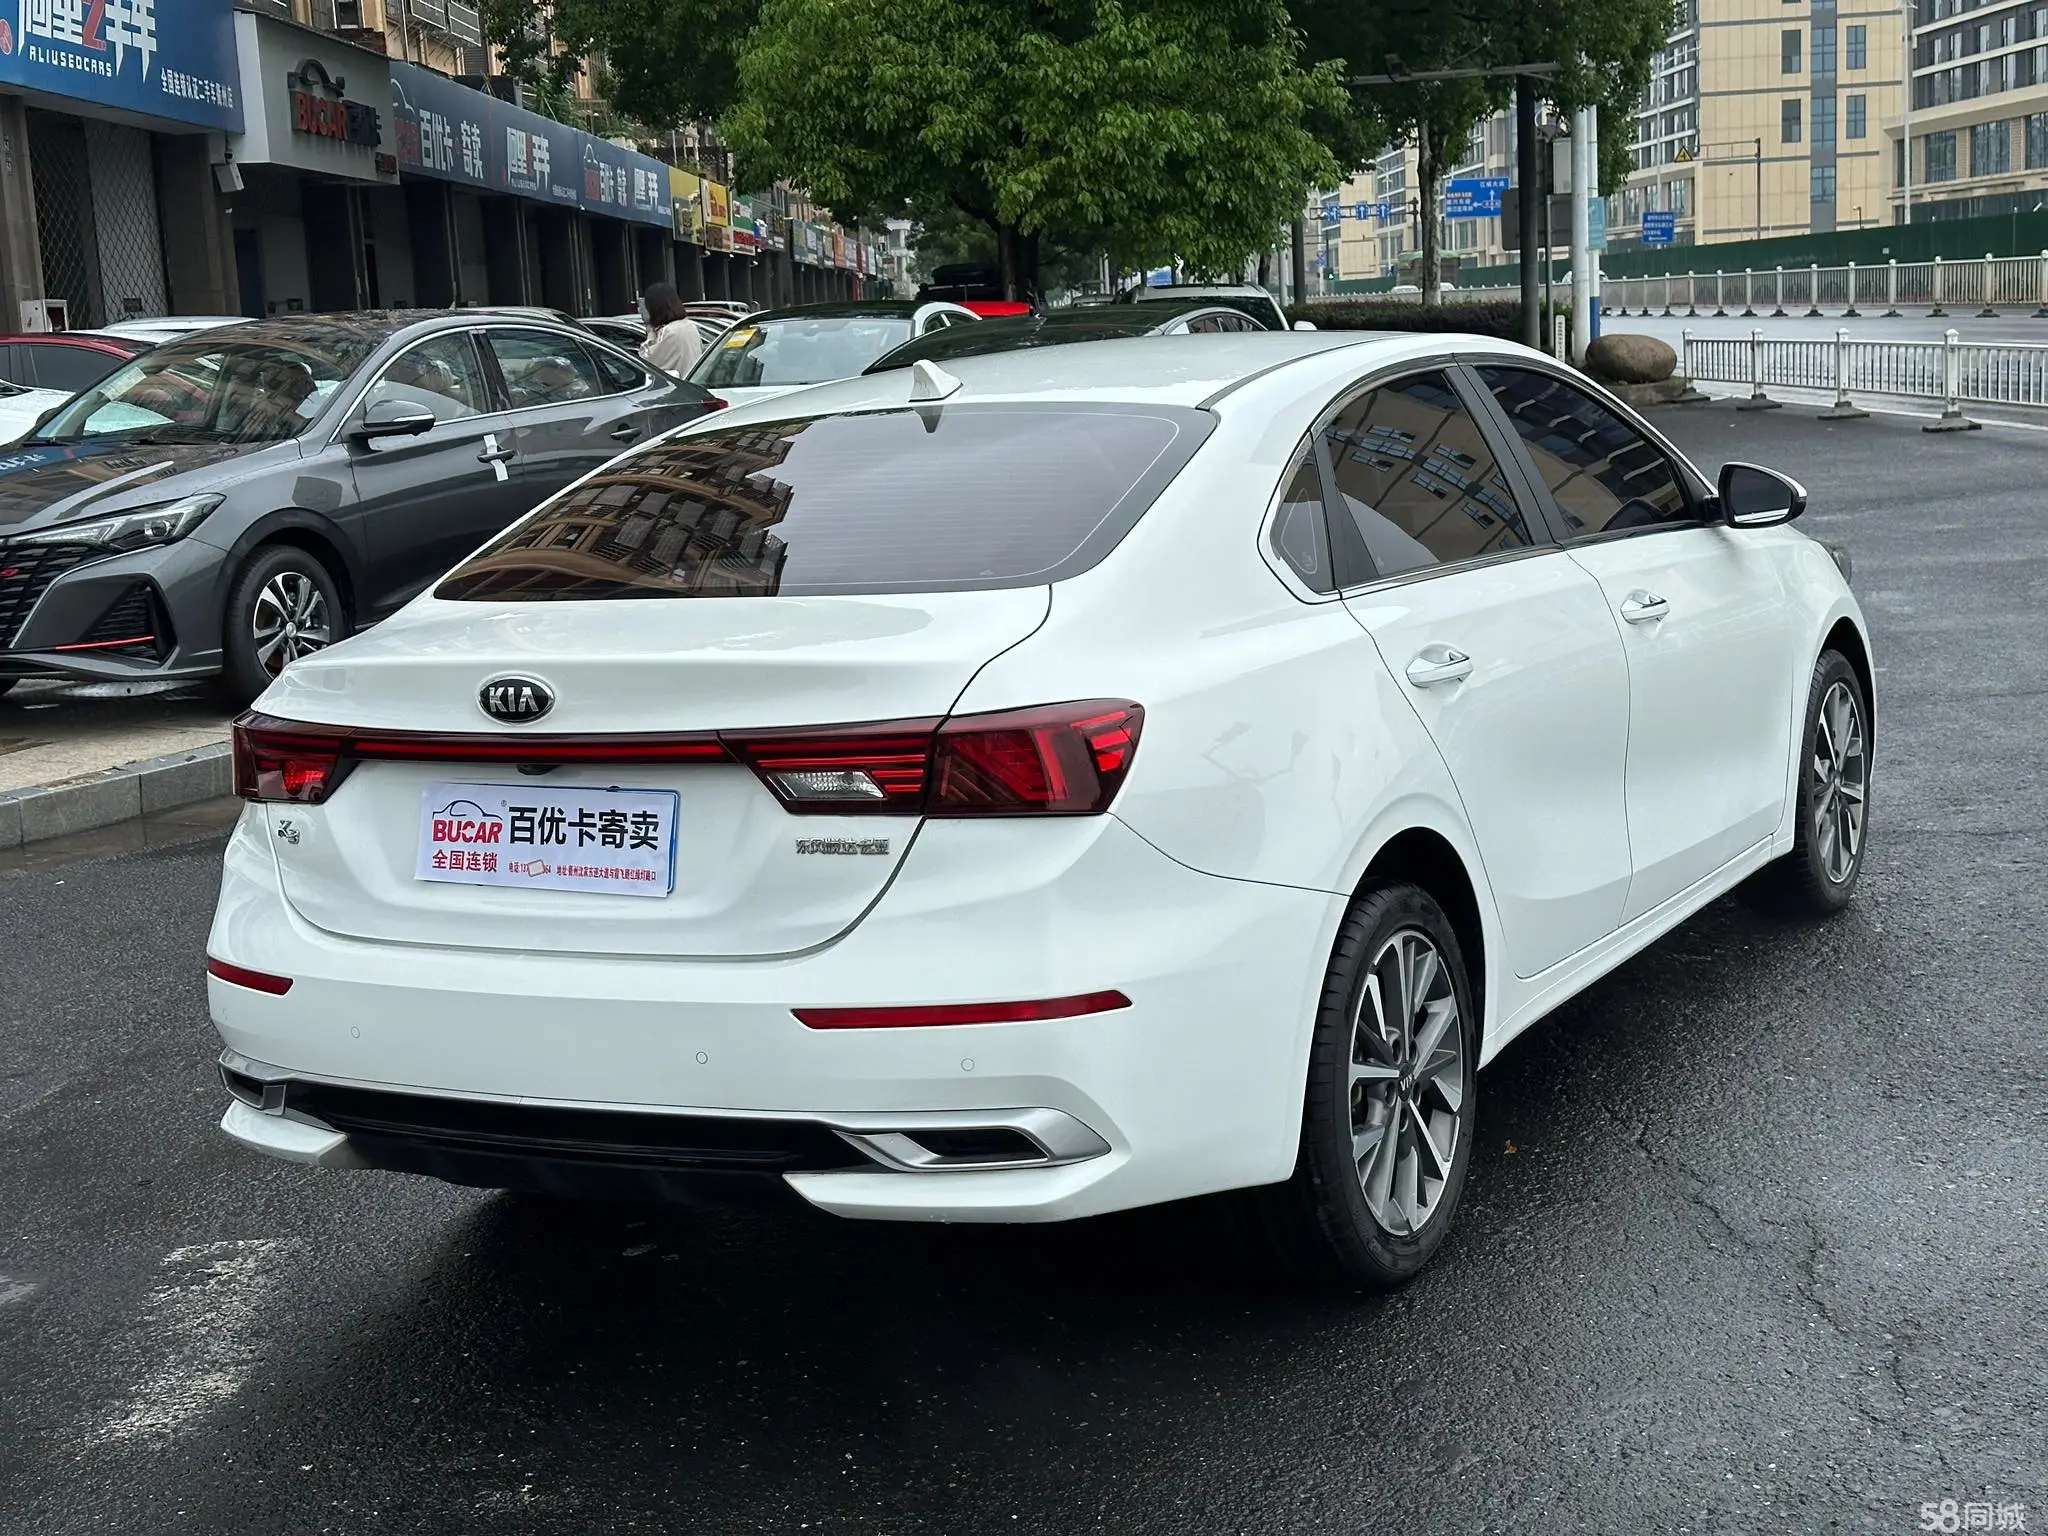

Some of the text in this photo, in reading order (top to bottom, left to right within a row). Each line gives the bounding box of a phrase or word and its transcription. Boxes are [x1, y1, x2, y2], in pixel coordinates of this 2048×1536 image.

[29, 45, 112, 77] ALIUSEDCARS
[291, 90, 348, 141] BUCAR
[489, 686, 539, 712] KIA
[432, 819, 503, 844] BUCAR
[508, 806, 660, 850] 百优卡寄卖
[795, 837, 890, 855] 东风悦达起亚
[432, 849, 498, 872] 全国连锁
